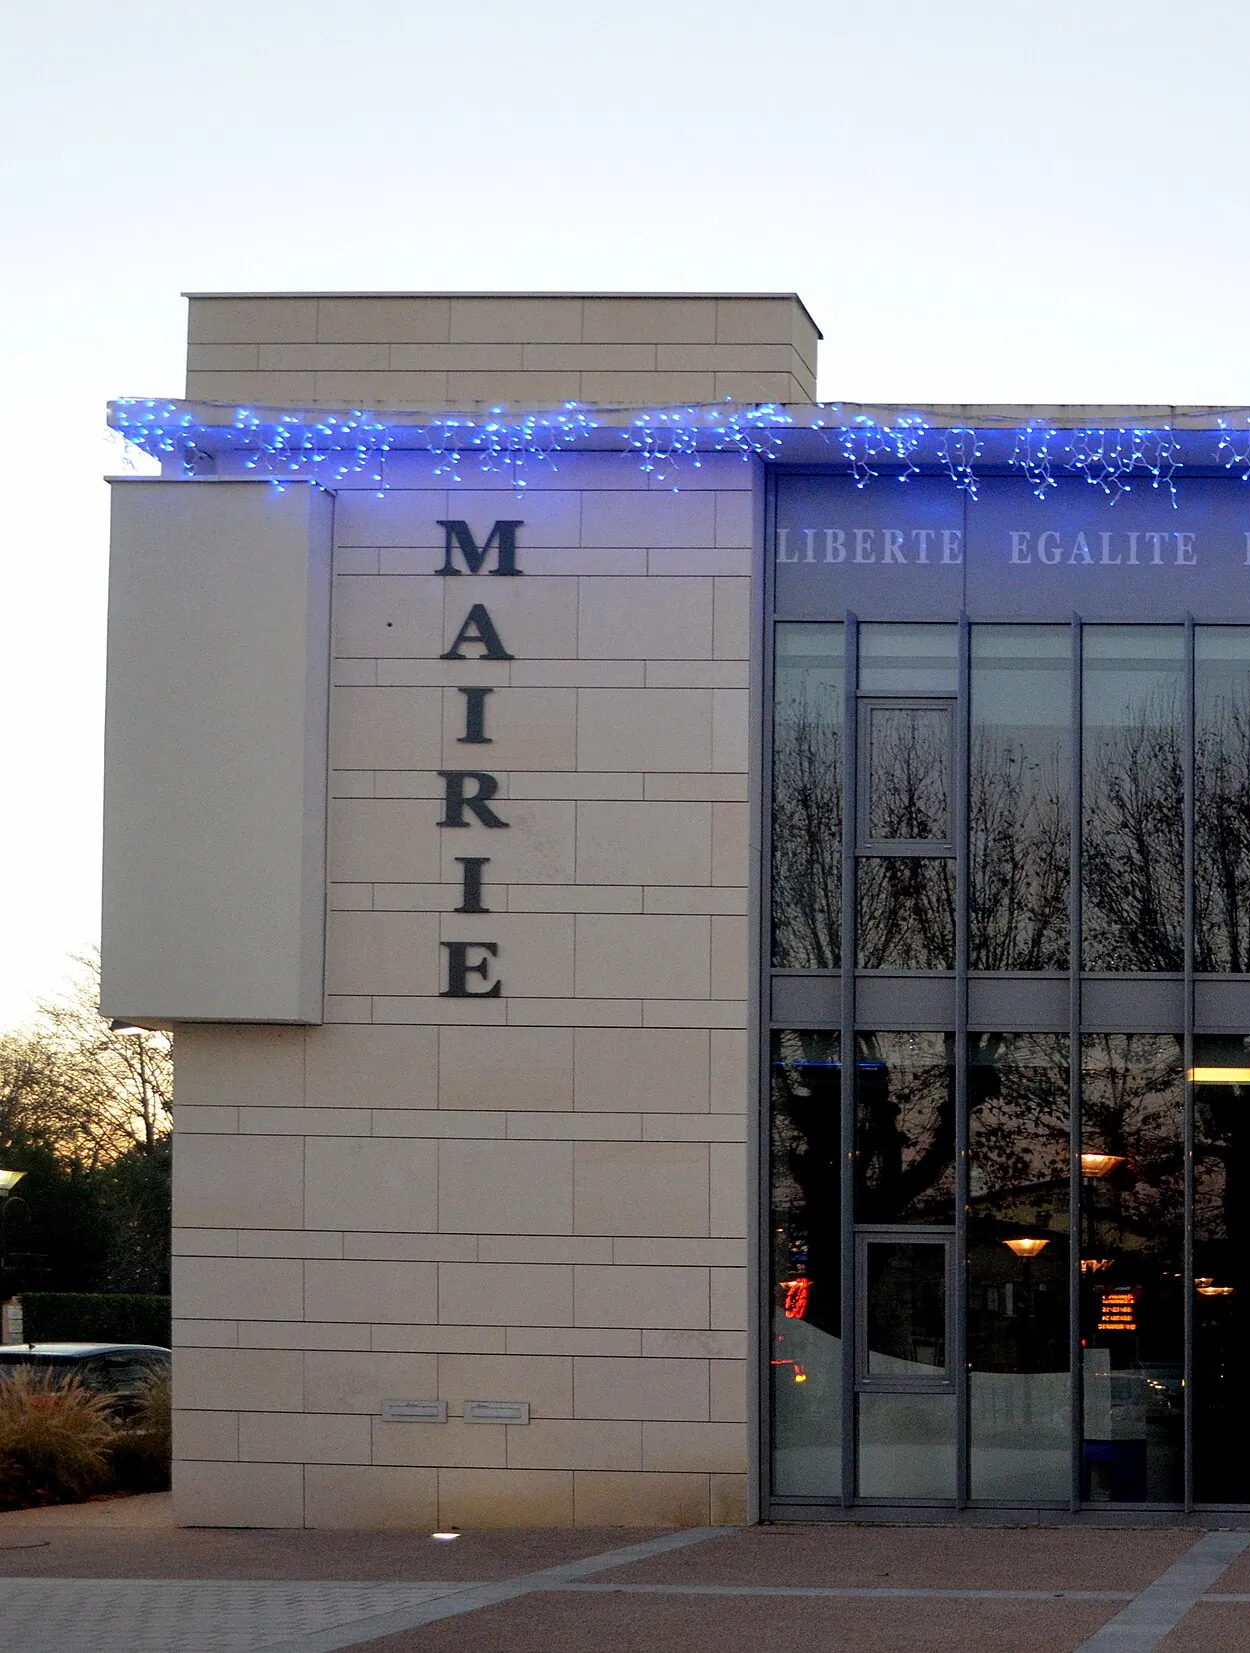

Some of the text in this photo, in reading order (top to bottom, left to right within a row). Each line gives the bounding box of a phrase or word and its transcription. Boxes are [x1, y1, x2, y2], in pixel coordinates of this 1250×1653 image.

[776, 529, 963, 565] LIBERTE
[1009, 531, 1198, 566] EGALITE
[434, 520, 524, 998] MAIRIE
